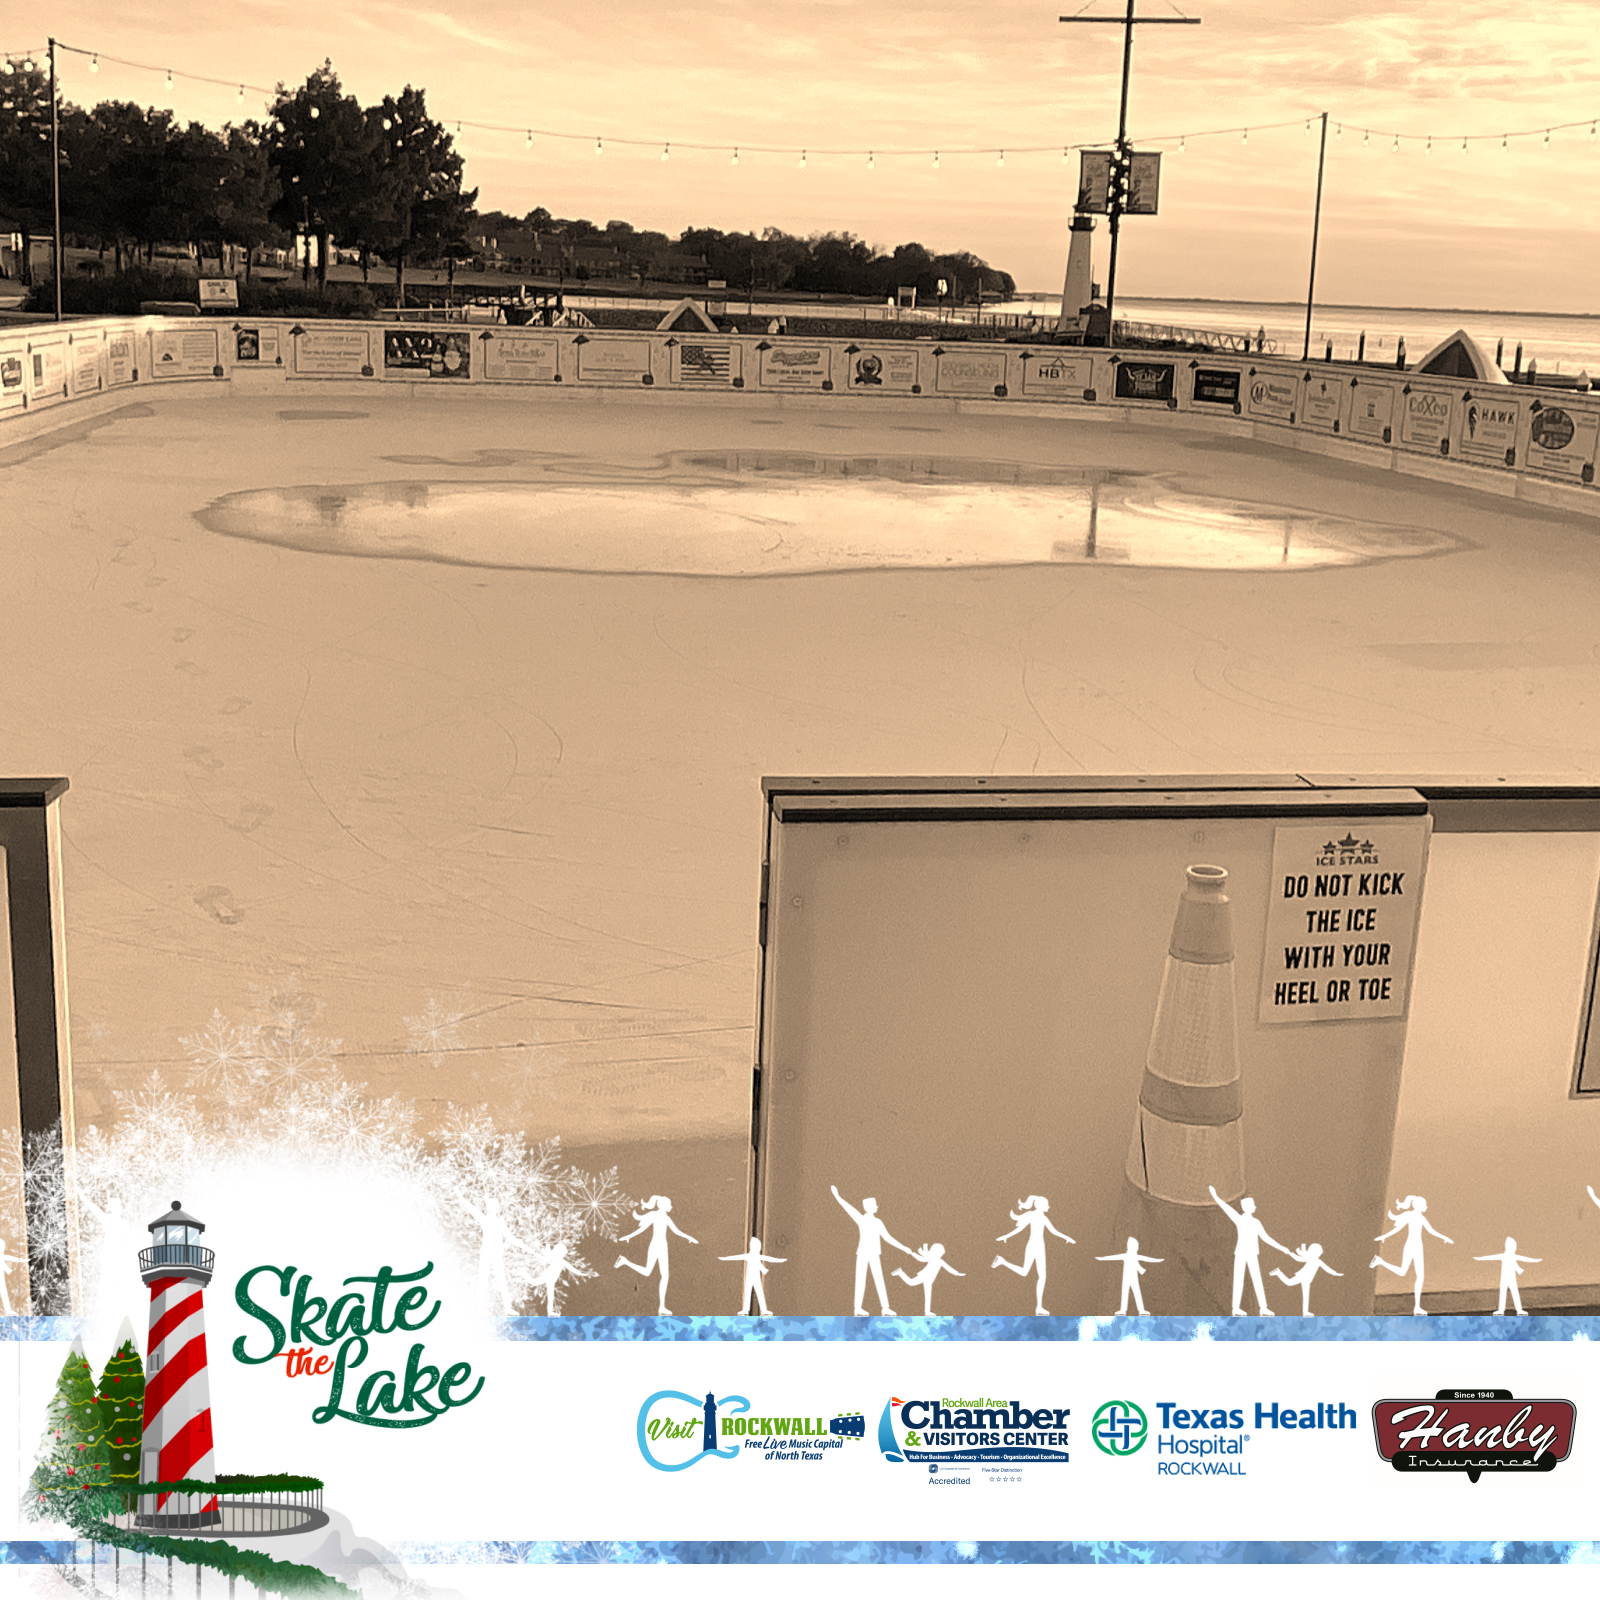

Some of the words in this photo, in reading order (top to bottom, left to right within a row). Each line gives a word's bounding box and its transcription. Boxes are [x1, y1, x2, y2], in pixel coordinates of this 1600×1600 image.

[1482, 408, 1515, 425] HAWK
[1316, 857, 1336, 866] ICE
[1339, 855, 1379, 866] STARS
[1284, 875, 1309, 898] DO
[1314, 874, 1353, 897] NOT
[1358, 872, 1405, 896] KICK
[1306, 909, 1341, 933] THE
[1346, 908, 1377, 931] ICE
[1284, 945, 1335, 969] WITH
[1342, 943, 1391, 967] YOUR
[1274, 981, 1319, 1005] HEEL
[1327, 980, 1350, 1002] OR
[1358, 978, 1392, 1000] TOE
